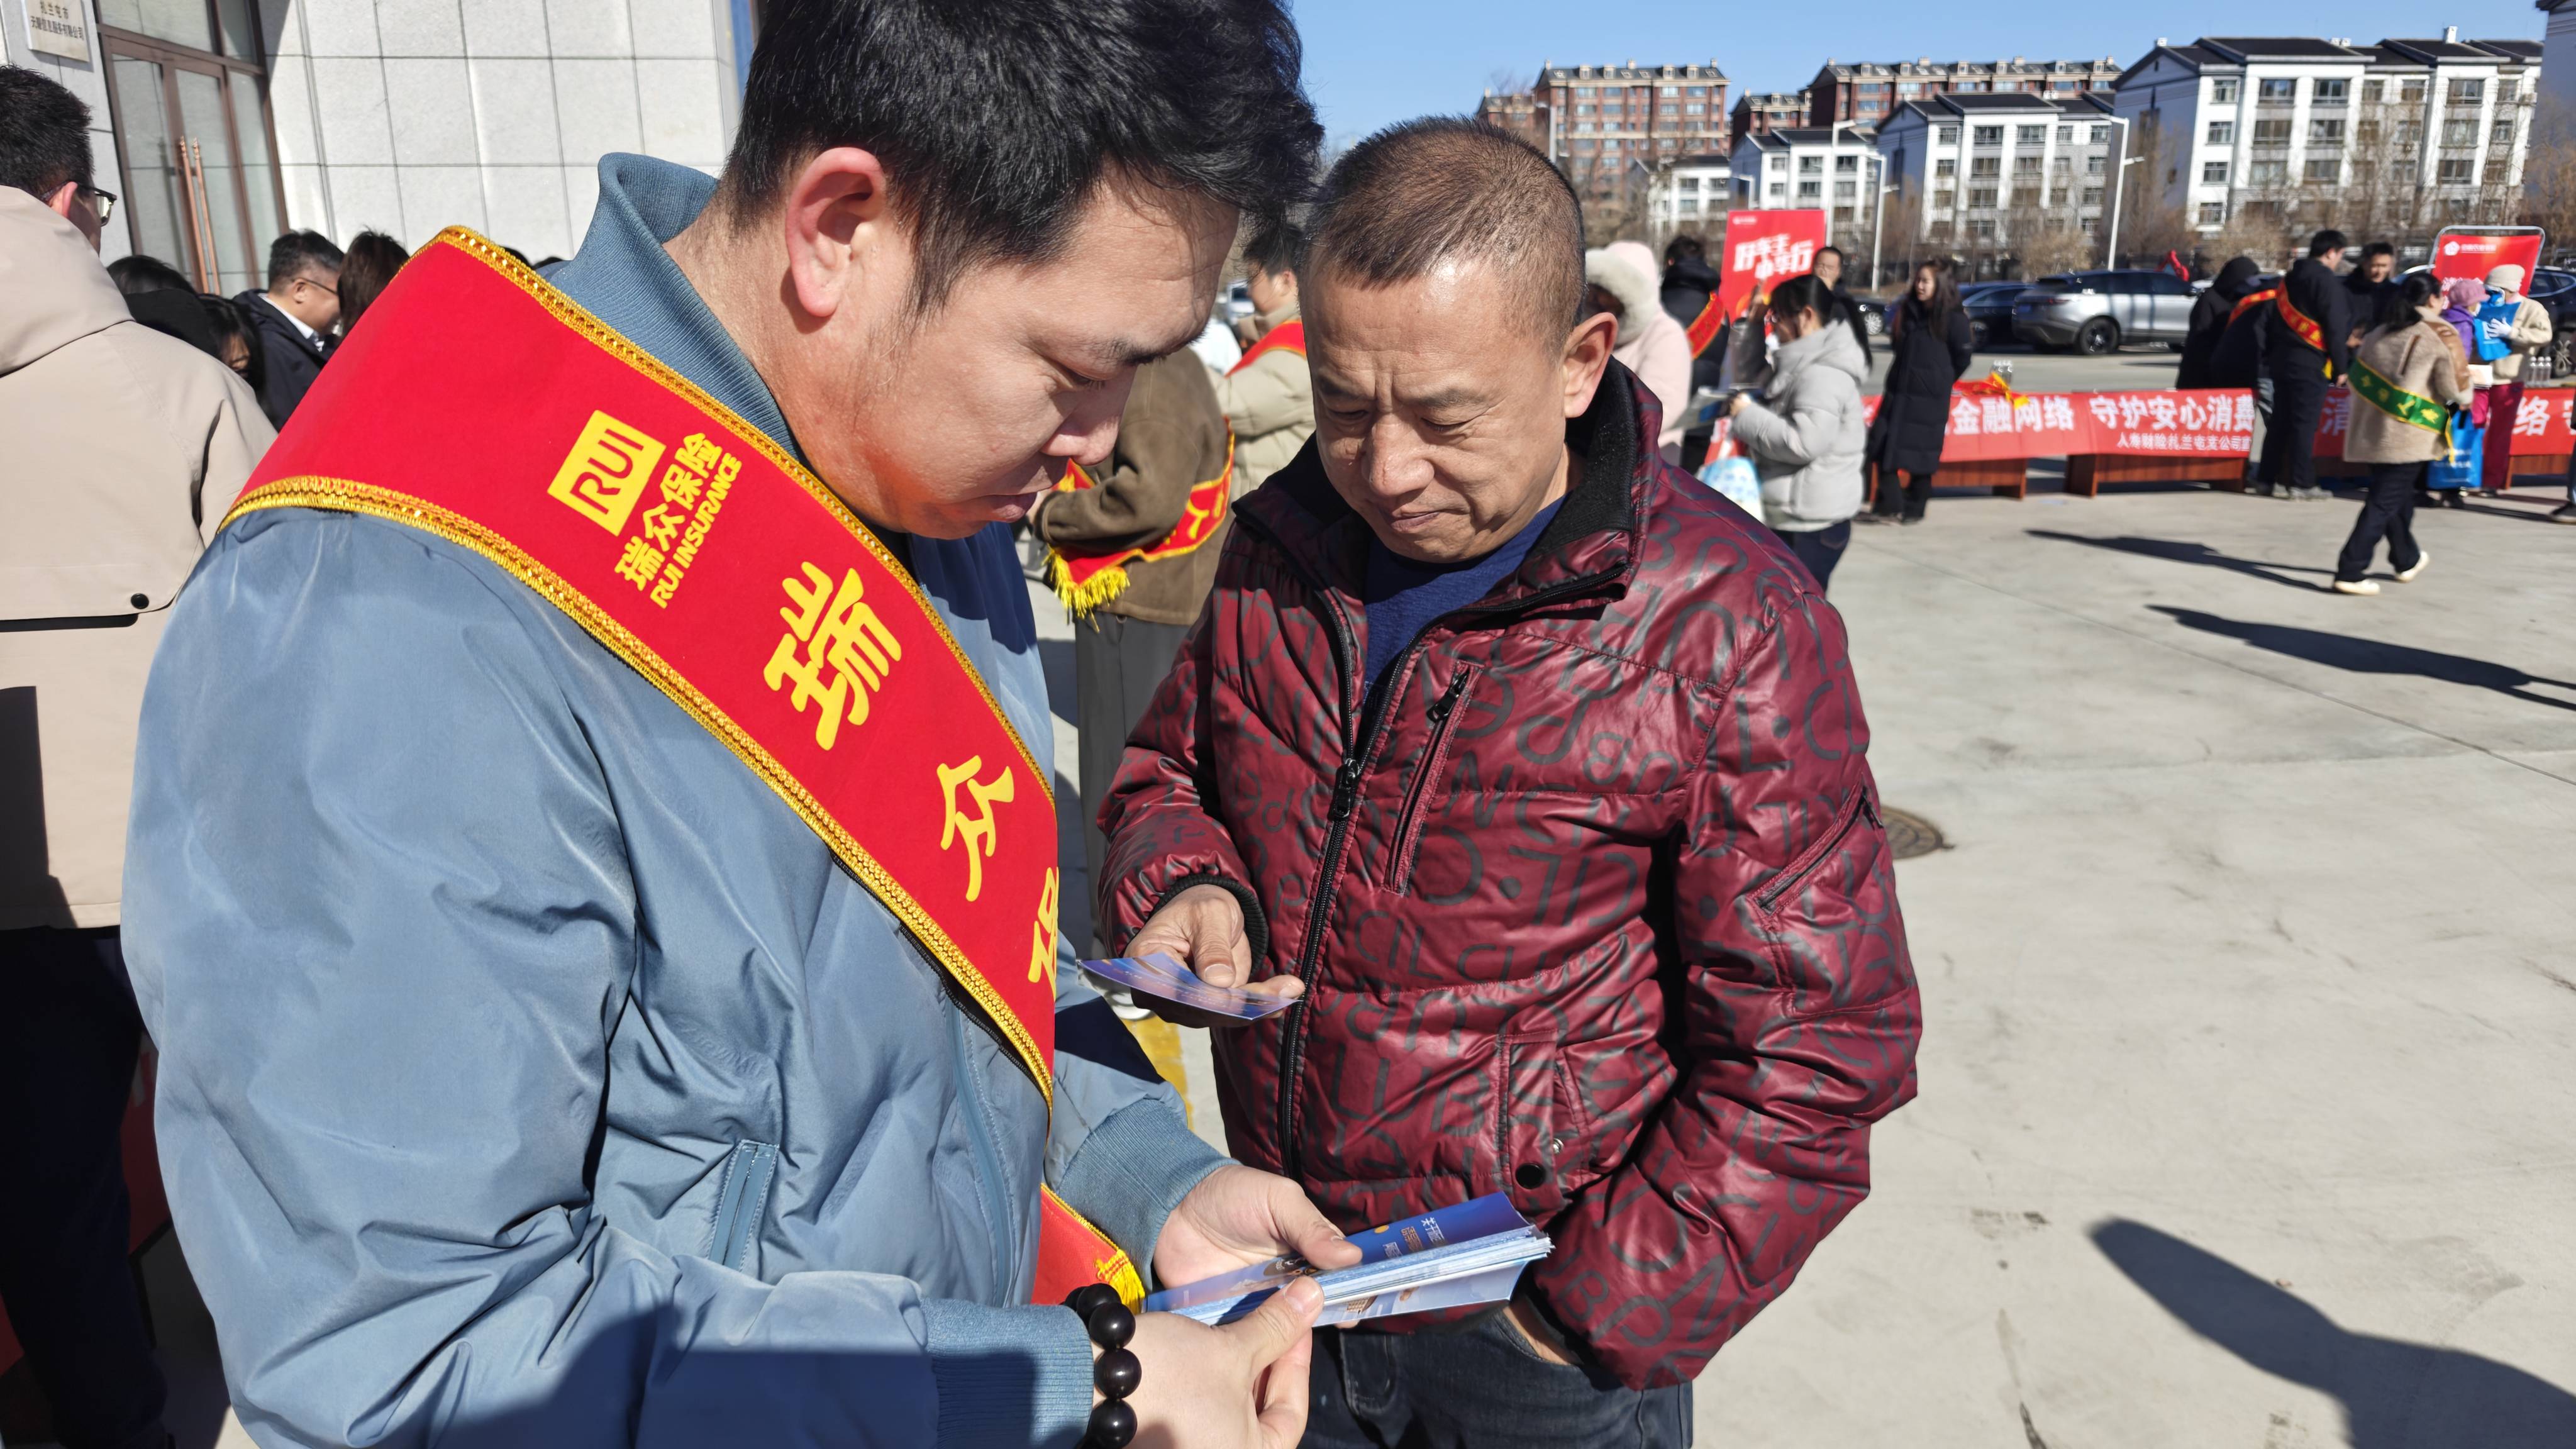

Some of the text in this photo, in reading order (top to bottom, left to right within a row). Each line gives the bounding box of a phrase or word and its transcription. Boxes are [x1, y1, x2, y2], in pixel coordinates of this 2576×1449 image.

[569, 428, 645, 515] RUI
[1945, 394, 2255, 435] 金融网络 守护安心消费
[614, 433, 723, 591] 瑞众保险
[650, 453, 743, 609] RUI INSURANCE
